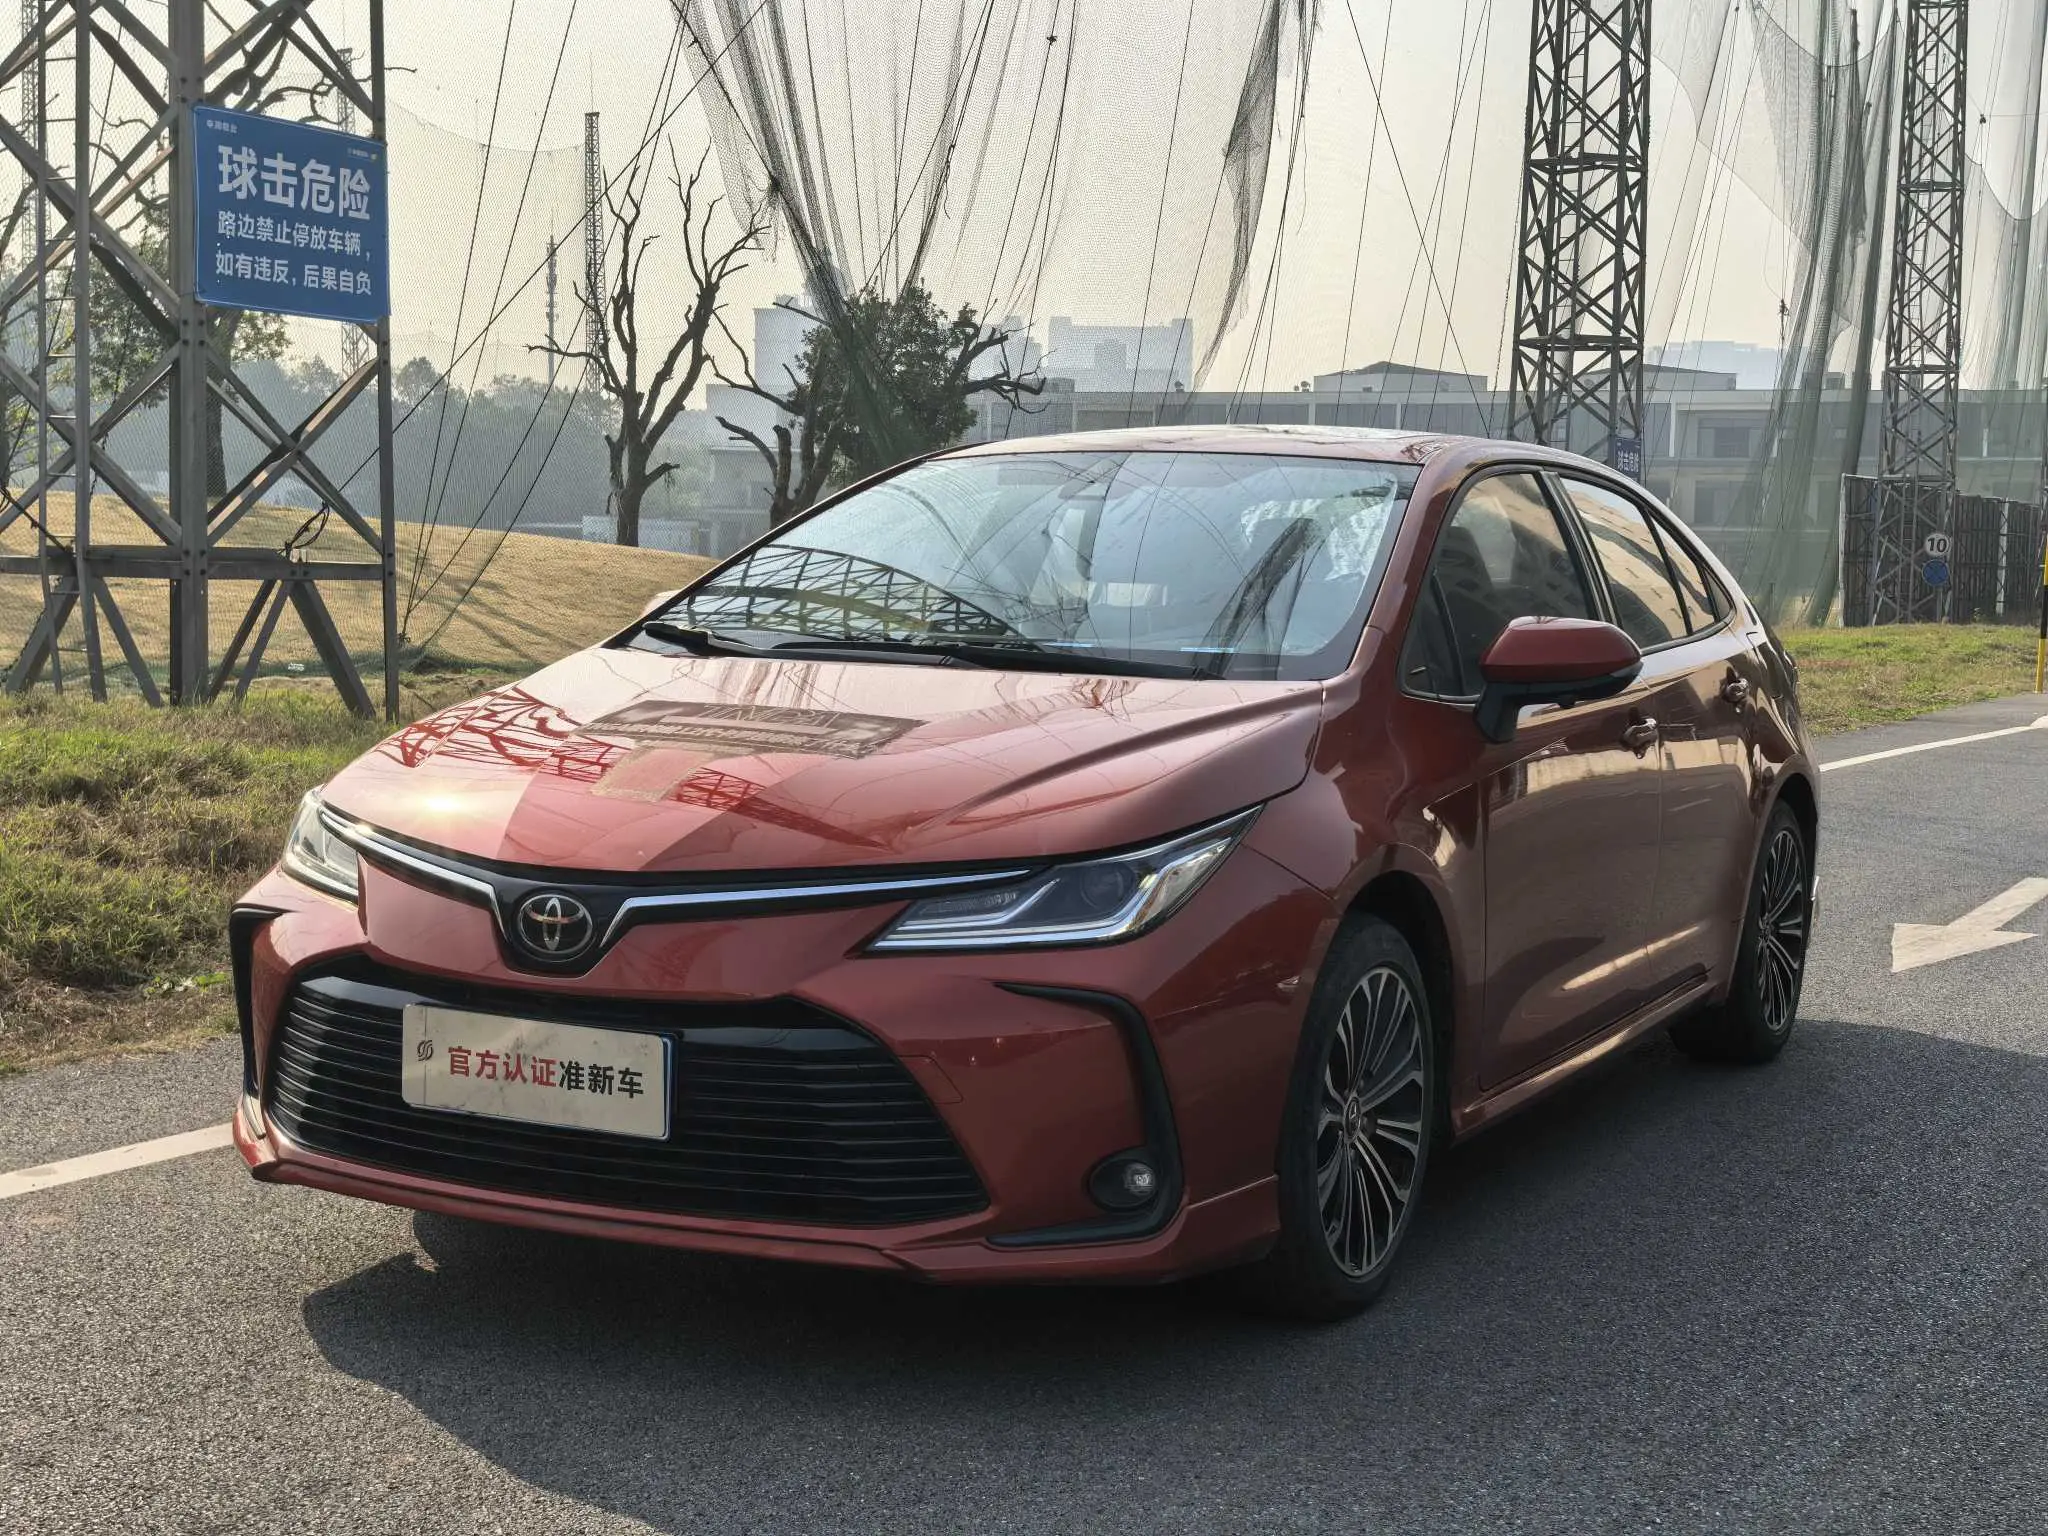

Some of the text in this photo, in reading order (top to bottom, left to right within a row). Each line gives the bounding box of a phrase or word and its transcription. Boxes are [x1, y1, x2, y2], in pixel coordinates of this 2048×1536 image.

[217, 144, 371, 220] 球击危险
[1927, 538, 1948, 553] 10
[447, 1045, 644, 1099] 官方认证准新车
